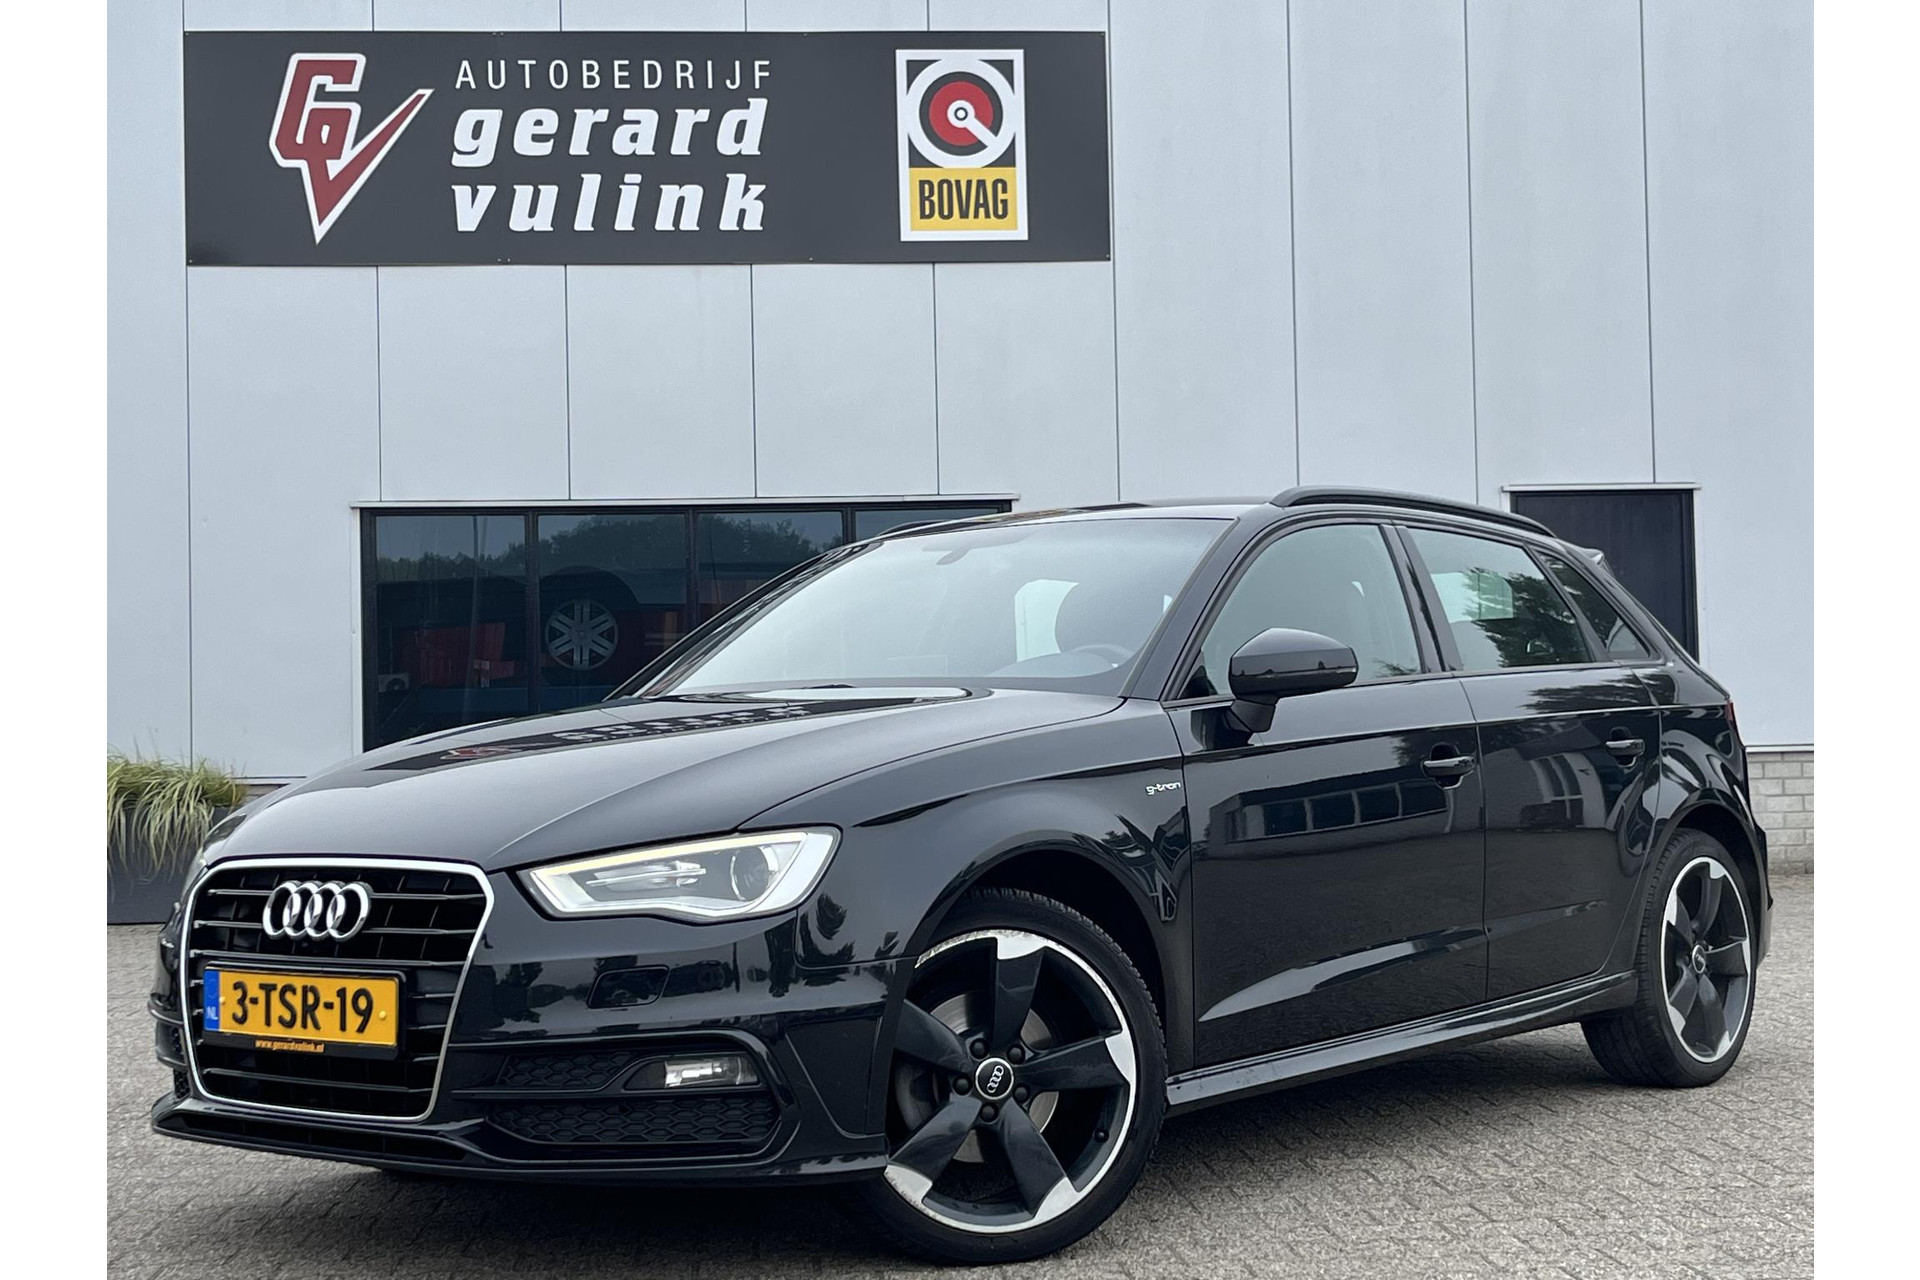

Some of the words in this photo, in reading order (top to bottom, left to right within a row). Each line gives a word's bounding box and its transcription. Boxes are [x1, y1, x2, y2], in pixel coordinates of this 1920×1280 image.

[455, 60, 770, 89] AUTOBEDRIJF
[451, 98, 768, 167] gerard
[451, 173, 766, 231] vulink
[918, 178, 1008, 220] BOVAG
[1146, 781, 1181, 795] g-tron
[206, 1006, 219, 1020] NL
[232, 980, 374, 1033] 3-TSR-19
